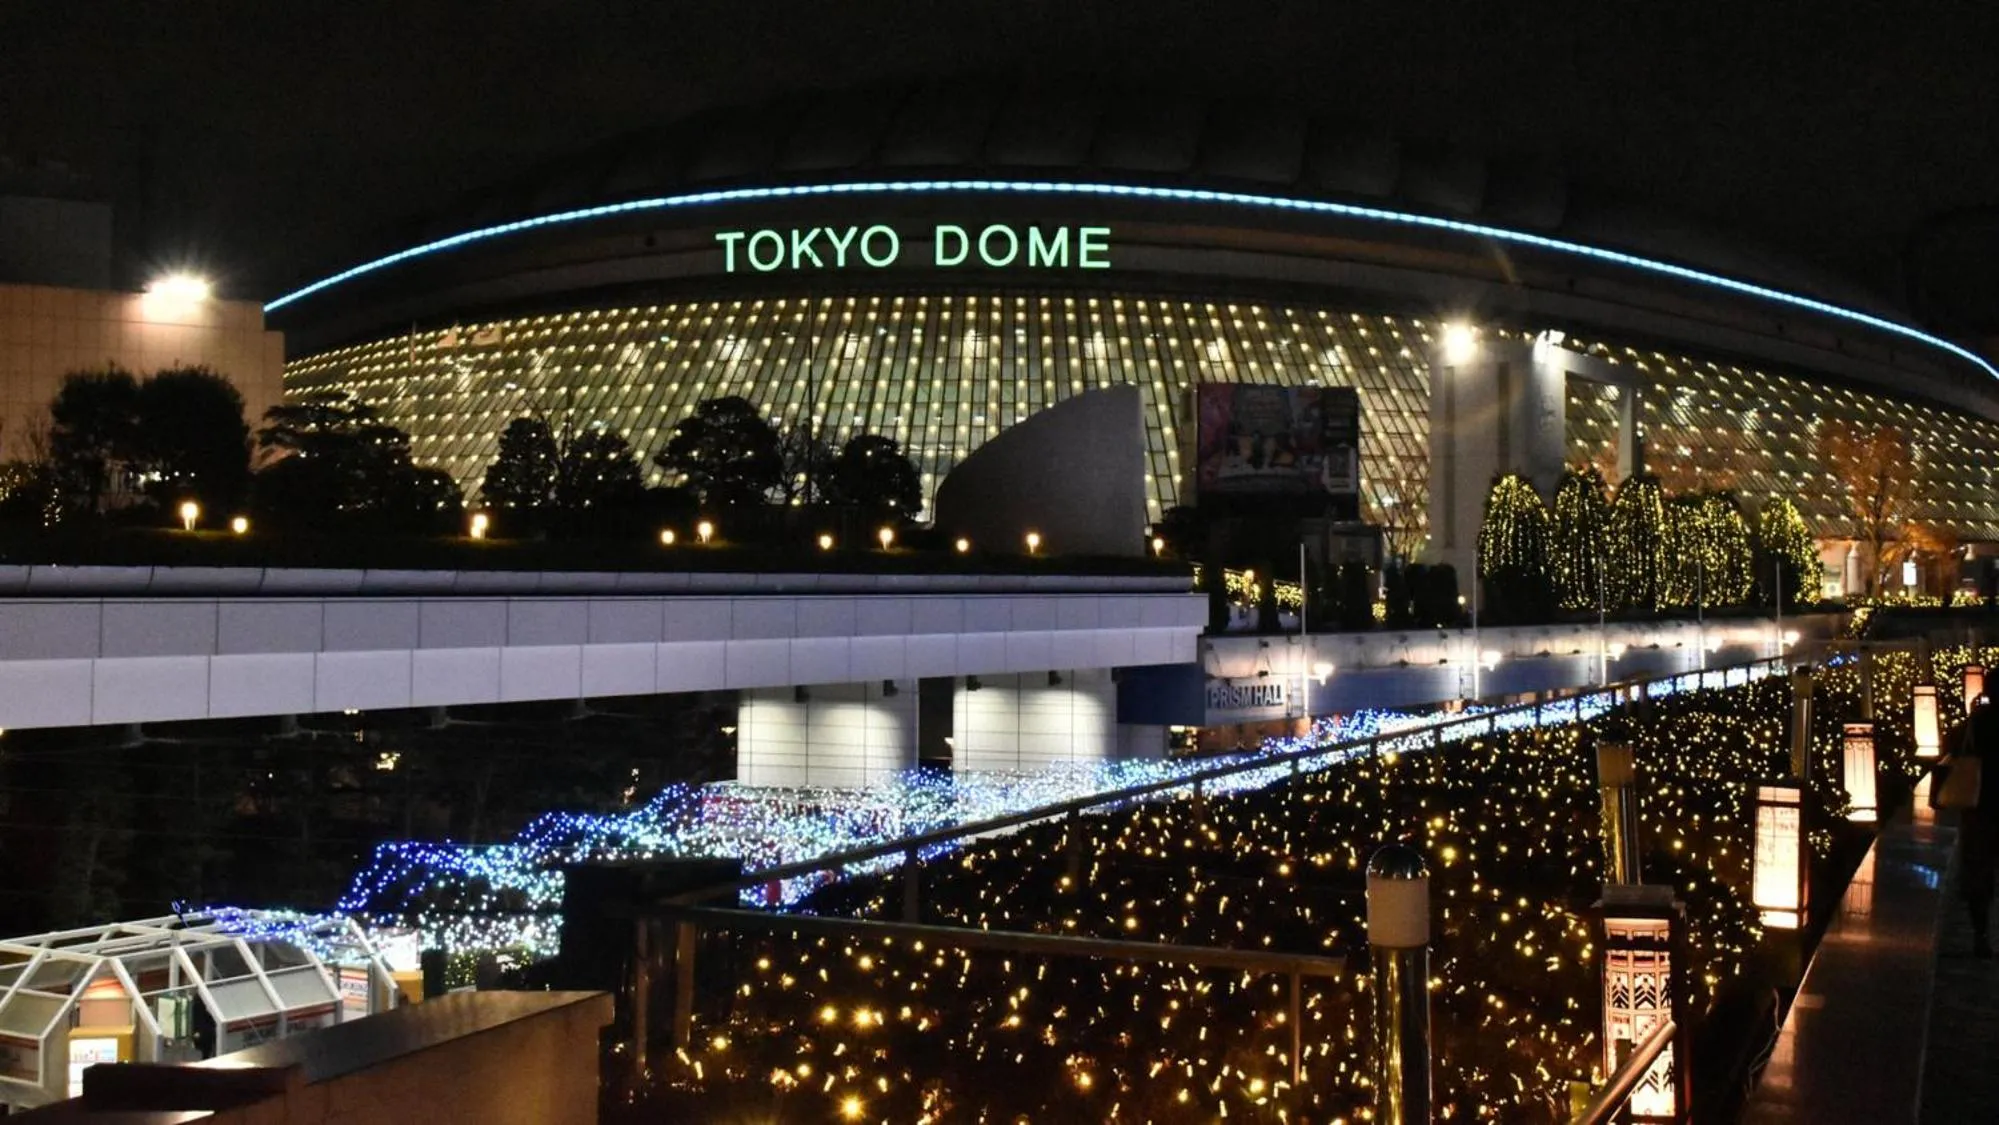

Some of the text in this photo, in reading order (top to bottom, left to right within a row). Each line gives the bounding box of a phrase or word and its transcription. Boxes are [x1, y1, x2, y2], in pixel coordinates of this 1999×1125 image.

[715, 224, 1111, 273] TOKYO DOME
[1208, 684, 1284, 709] PRISM HALL
